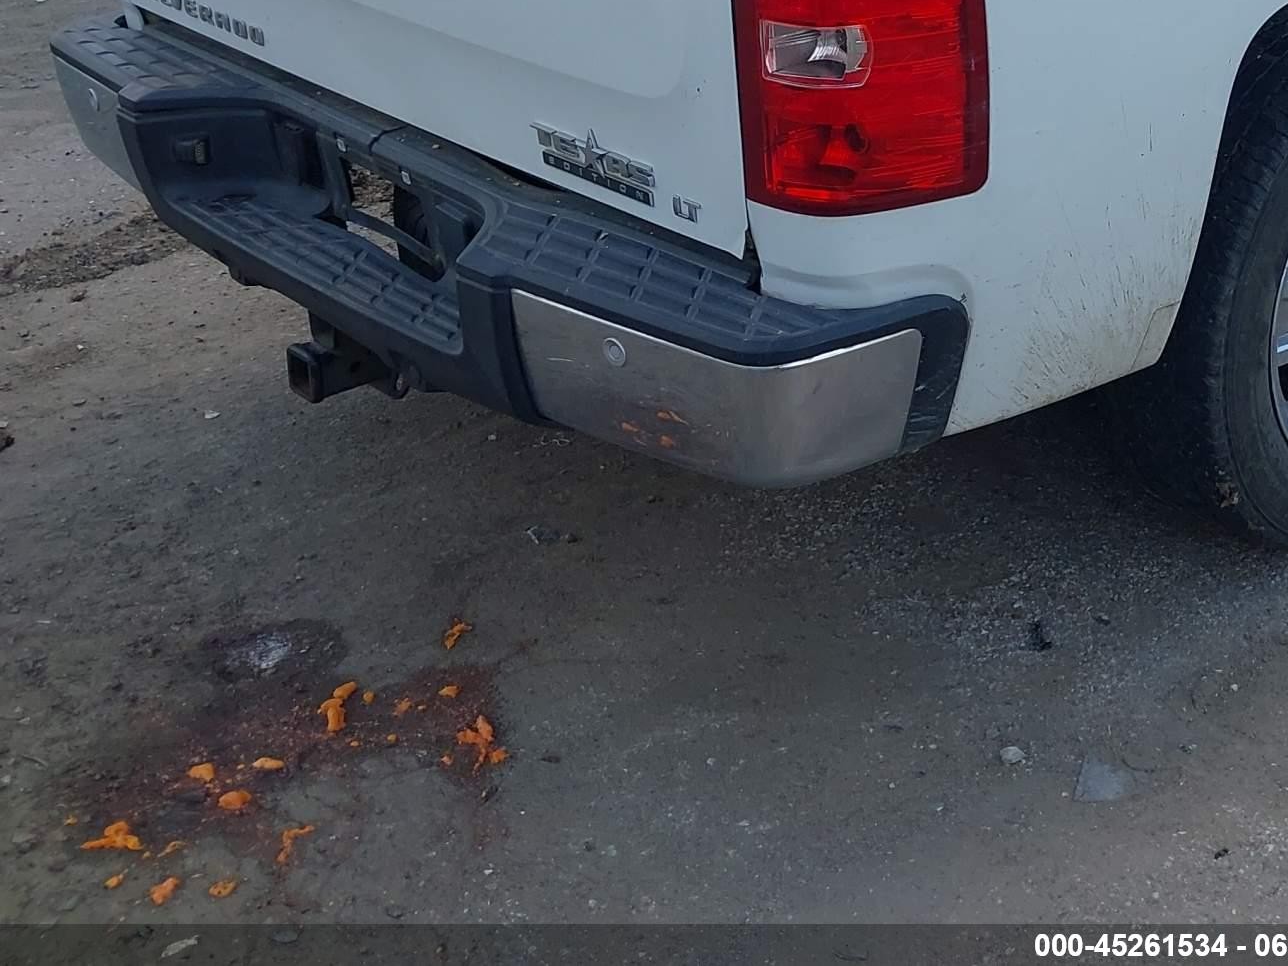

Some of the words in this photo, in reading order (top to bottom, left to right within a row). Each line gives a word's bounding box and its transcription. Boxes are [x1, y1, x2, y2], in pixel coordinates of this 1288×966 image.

[529, 121, 656, 188] TEXAS
[547, 156, 646, 201] EDITION
[672, 193, 702, 224] LT
